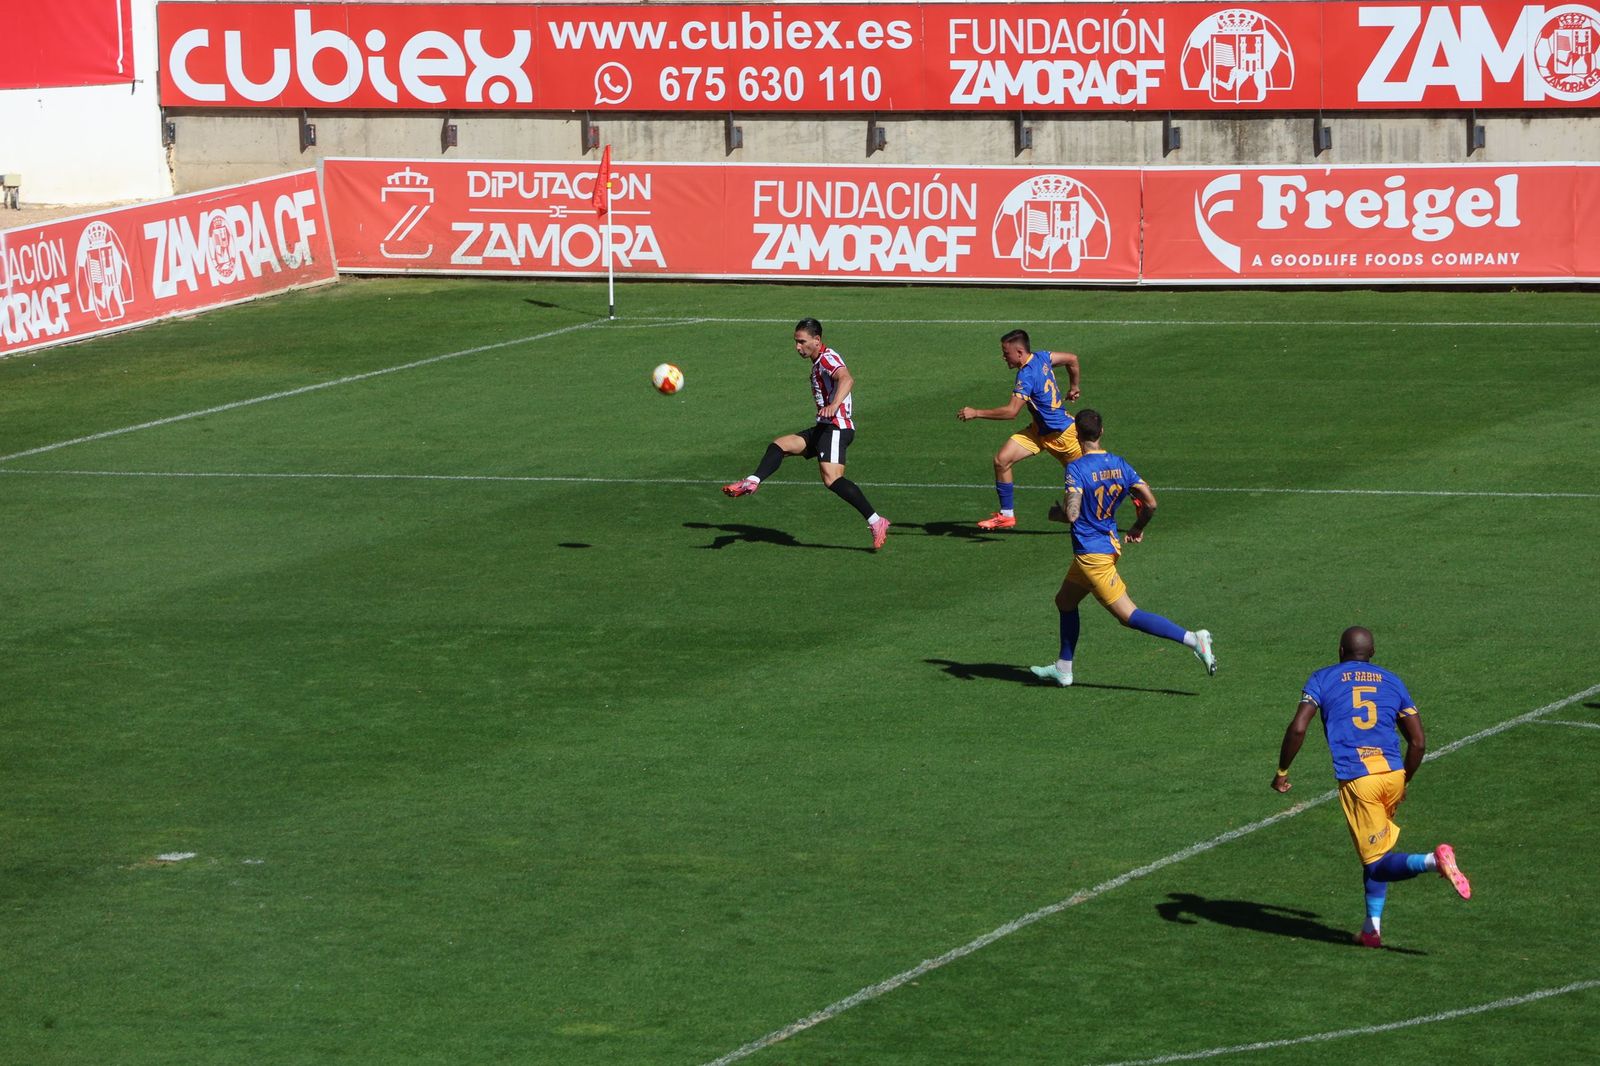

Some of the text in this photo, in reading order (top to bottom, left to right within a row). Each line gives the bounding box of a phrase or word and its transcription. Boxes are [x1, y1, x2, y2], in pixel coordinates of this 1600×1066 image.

[548, 13, 913, 50] www.cubiex.es
[949, 9, 1165, 55] FUNDACIÓN
[169, 9, 533, 105] cubiex
[659, 66, 882, 102] 675 630 110
[949, 60, 1166, 105] ZAMORACF
[753, 172, 977, 221] FUNDACIÓN
[1257, 173, 1521, 242] Freigel
[143, 189, 317, 299] ZAMORA CF
[451, 222, 667, 268] ZAMORA
[752, 223, 977, 273] ZAMORACF
[1252, 252, 1520, 267] A GOODLIFE FOODS COMPANY
[1352, 686, 1378, 730] 5
